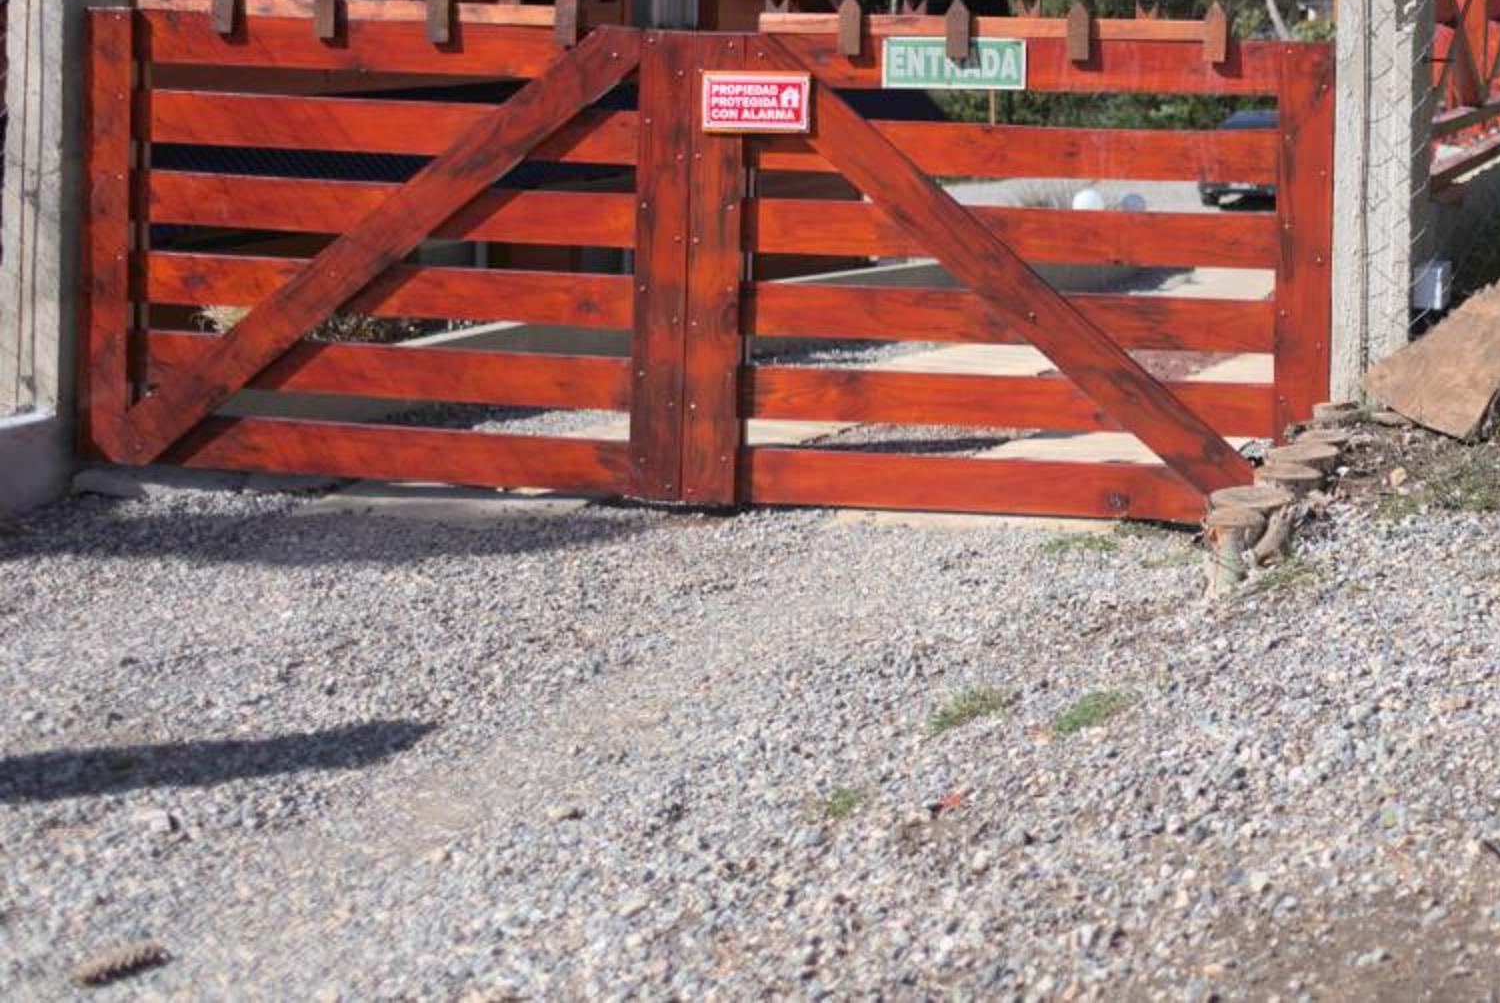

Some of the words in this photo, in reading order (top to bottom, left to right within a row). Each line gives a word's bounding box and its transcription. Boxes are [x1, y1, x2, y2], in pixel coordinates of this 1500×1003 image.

[711, 84, 778, 96] PROPIEDAD
[711, 96, 778, 108] PROTEGIDA
[711, 108, 739, 119] CON
[742, 108, 795, 120] ALARMA
